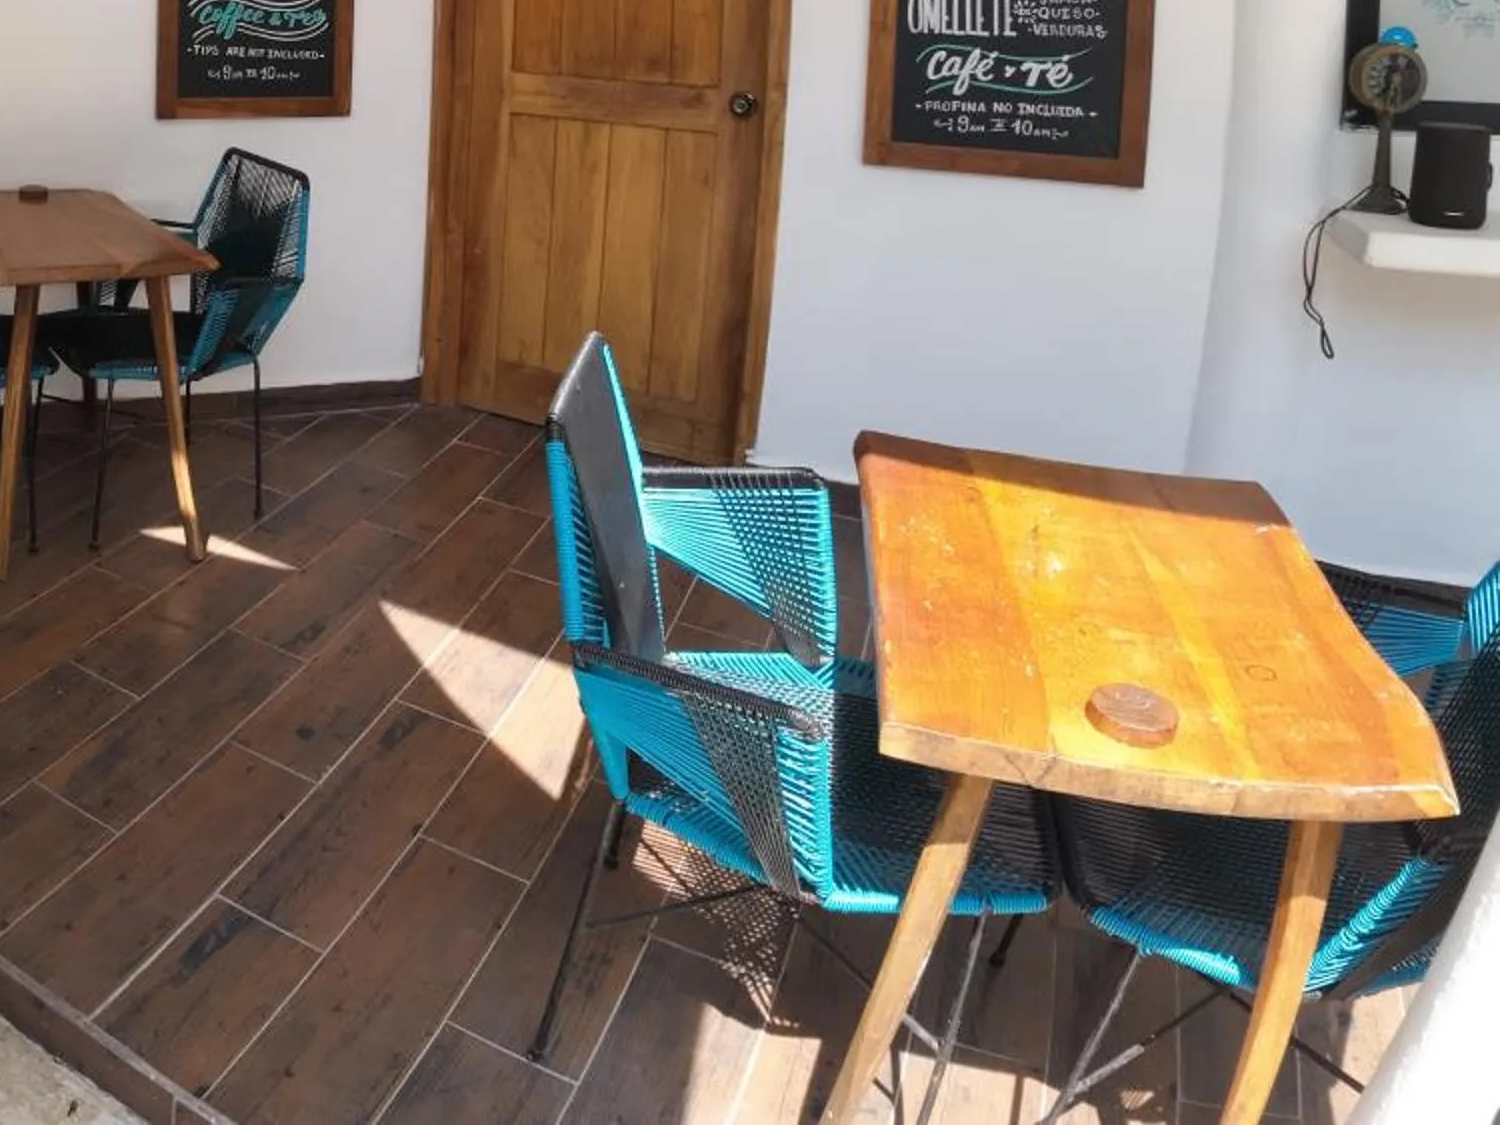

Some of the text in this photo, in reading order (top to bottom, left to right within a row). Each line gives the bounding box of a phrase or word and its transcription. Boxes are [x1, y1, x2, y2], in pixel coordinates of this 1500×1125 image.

[198, 0, 265, 39] Coffee
[193, 44, 219, 55] TIPS
[926, 47, 999, 96] Café
[993, 101, 1013, 113] NO
[1017, 103, 1085, 117] INCLUIDA
